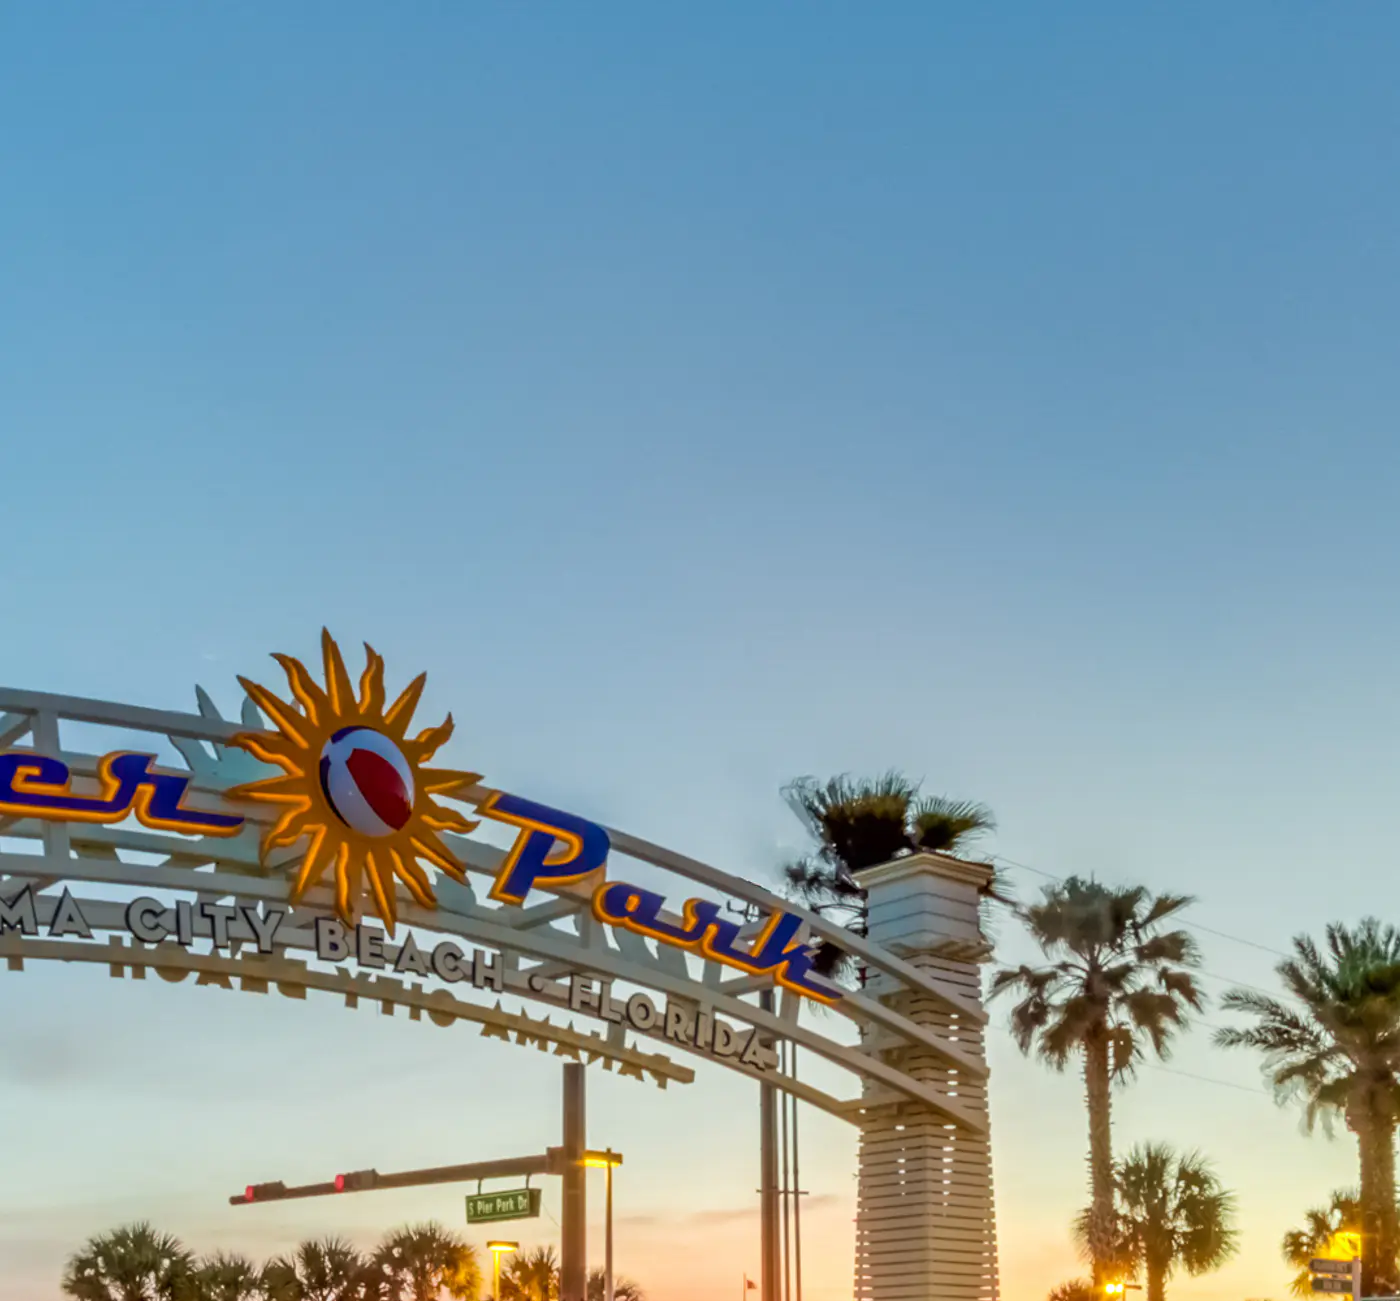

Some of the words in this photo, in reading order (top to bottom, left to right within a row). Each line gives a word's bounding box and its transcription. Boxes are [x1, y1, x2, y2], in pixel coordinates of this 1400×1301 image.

[125, 896, 284, 954] CITY
[314, 916, 504, 993] BEACH
[569, 972, 768, 1072] FLORIDA
[480, 790, 845, 1004] Park
[477, 1200, 494, 1217] Pier
[496, 1197, 515, 1213] Park
[517, 1195, 528, 1211] Dr
